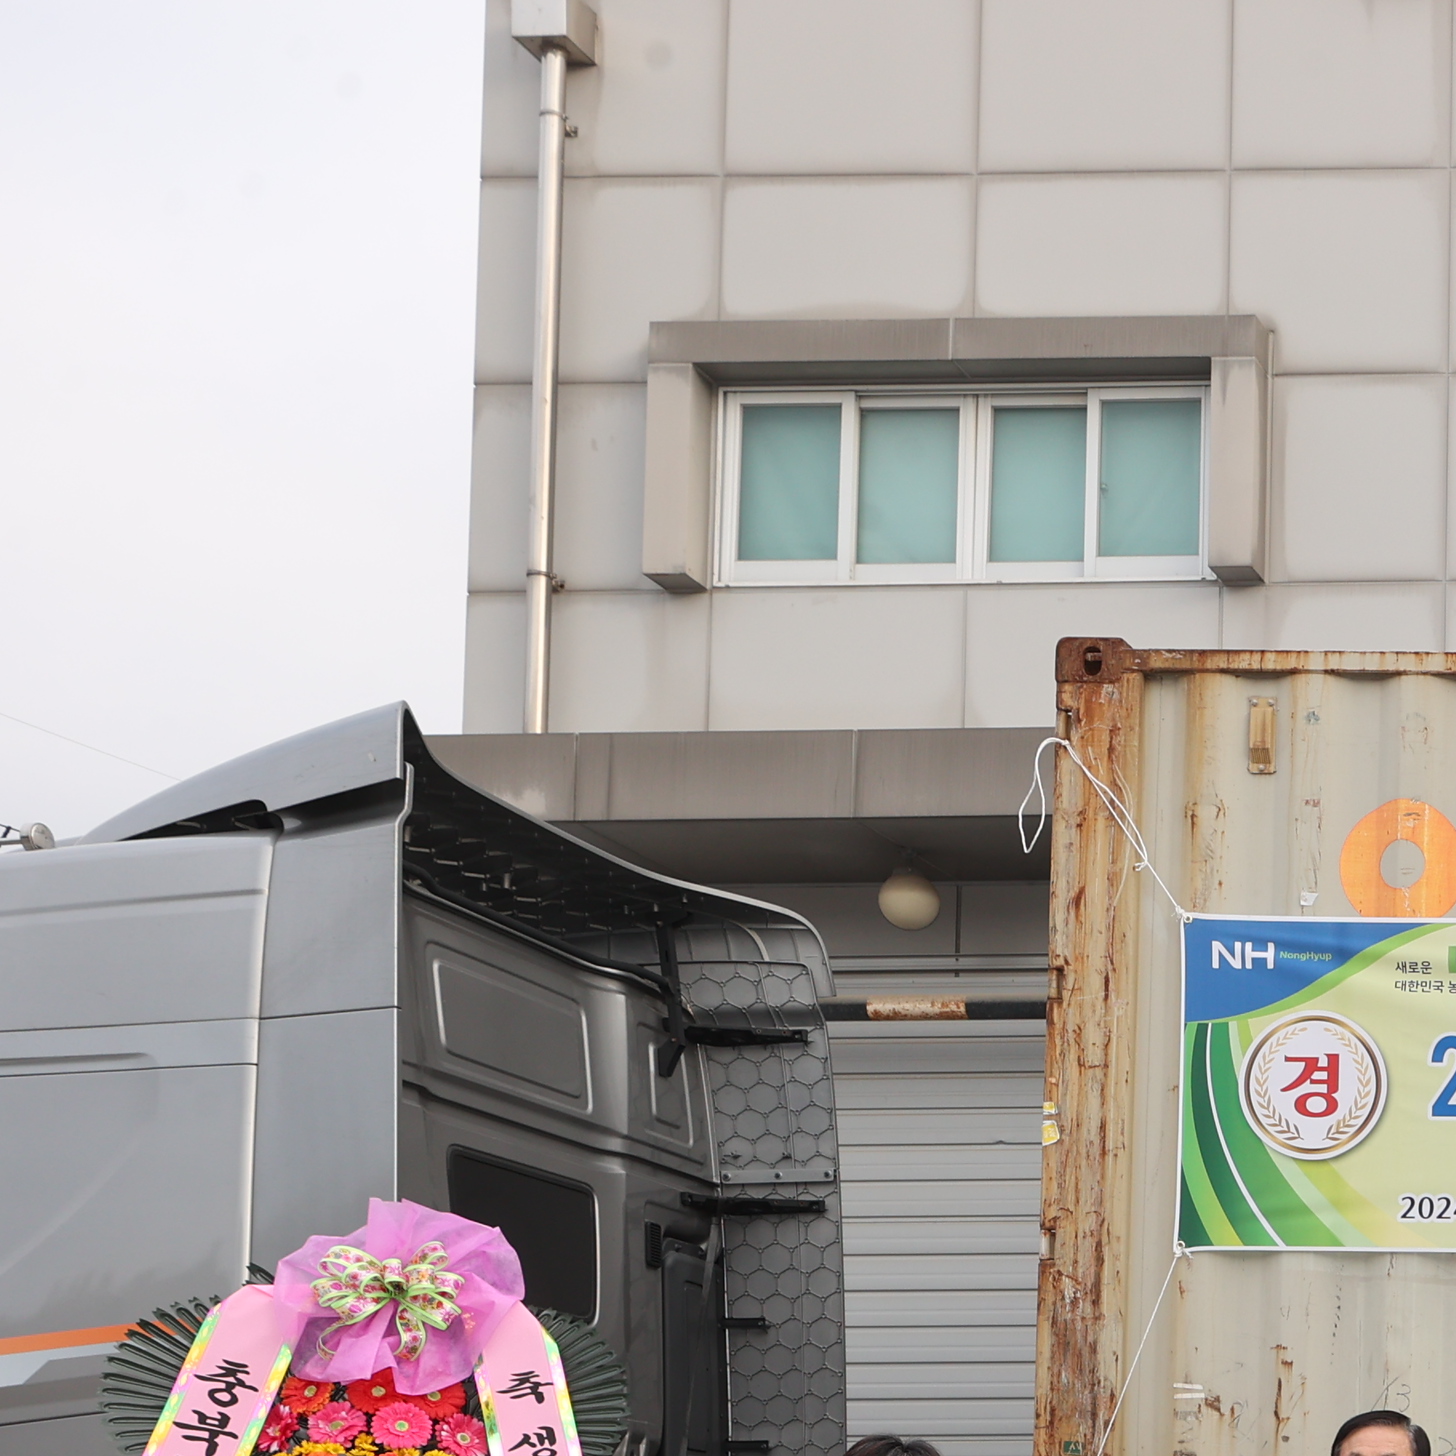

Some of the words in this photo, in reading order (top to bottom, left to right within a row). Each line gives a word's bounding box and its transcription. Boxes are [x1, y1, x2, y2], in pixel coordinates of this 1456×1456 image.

[1211, 940, 1275, 970] NH
[1279, 950, 1333, 962] NongHyup
[1394, 961, 1433, 976] 새로운
[1394, 979, 1444, 995] 대한민국
[1279, 1052, 1340, 1118] 경
[495, 1369, 555, 1404] 축
